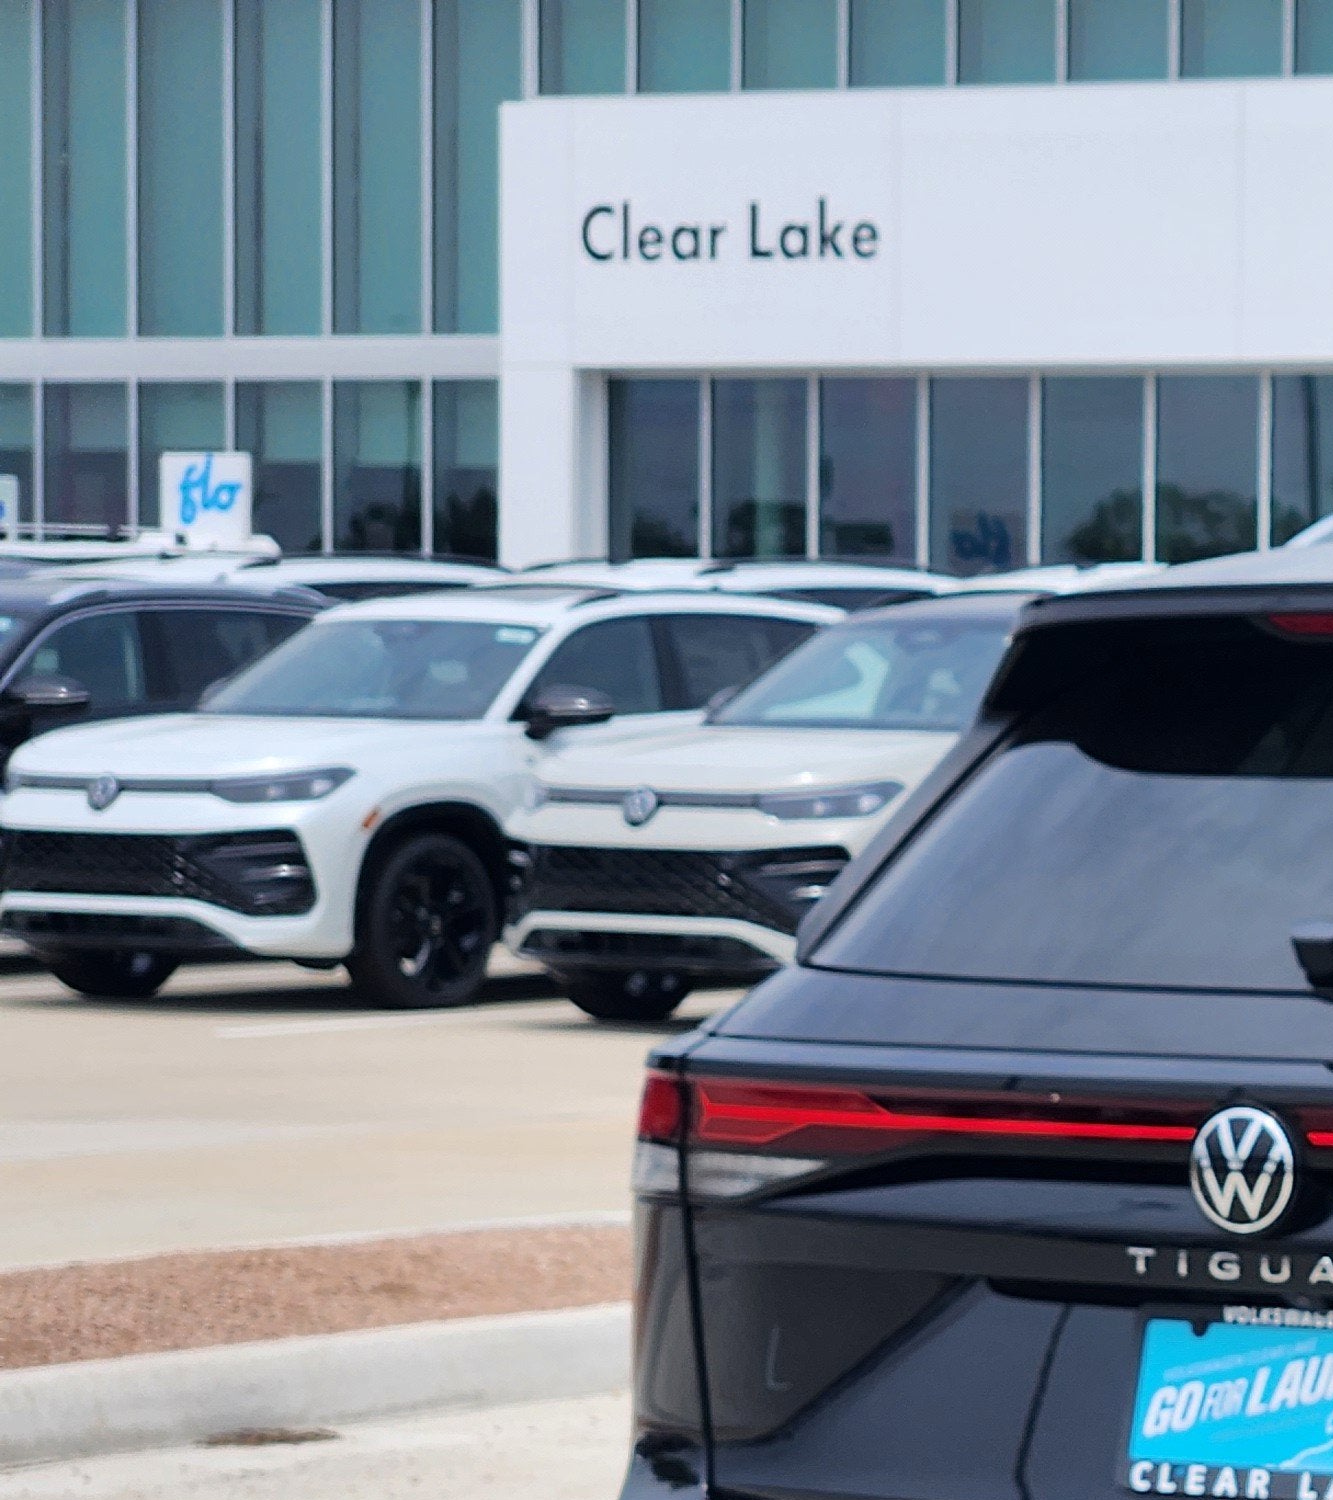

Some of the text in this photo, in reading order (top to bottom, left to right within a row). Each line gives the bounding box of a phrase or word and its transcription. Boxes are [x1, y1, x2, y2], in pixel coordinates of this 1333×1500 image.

[581, 196, 878, 261] Clear Lake
[179, 452, 242, 524] flo
[1142, 1381, 1204, 1438] GO
[1129, 1460, 1271, 1500] CLEAR
